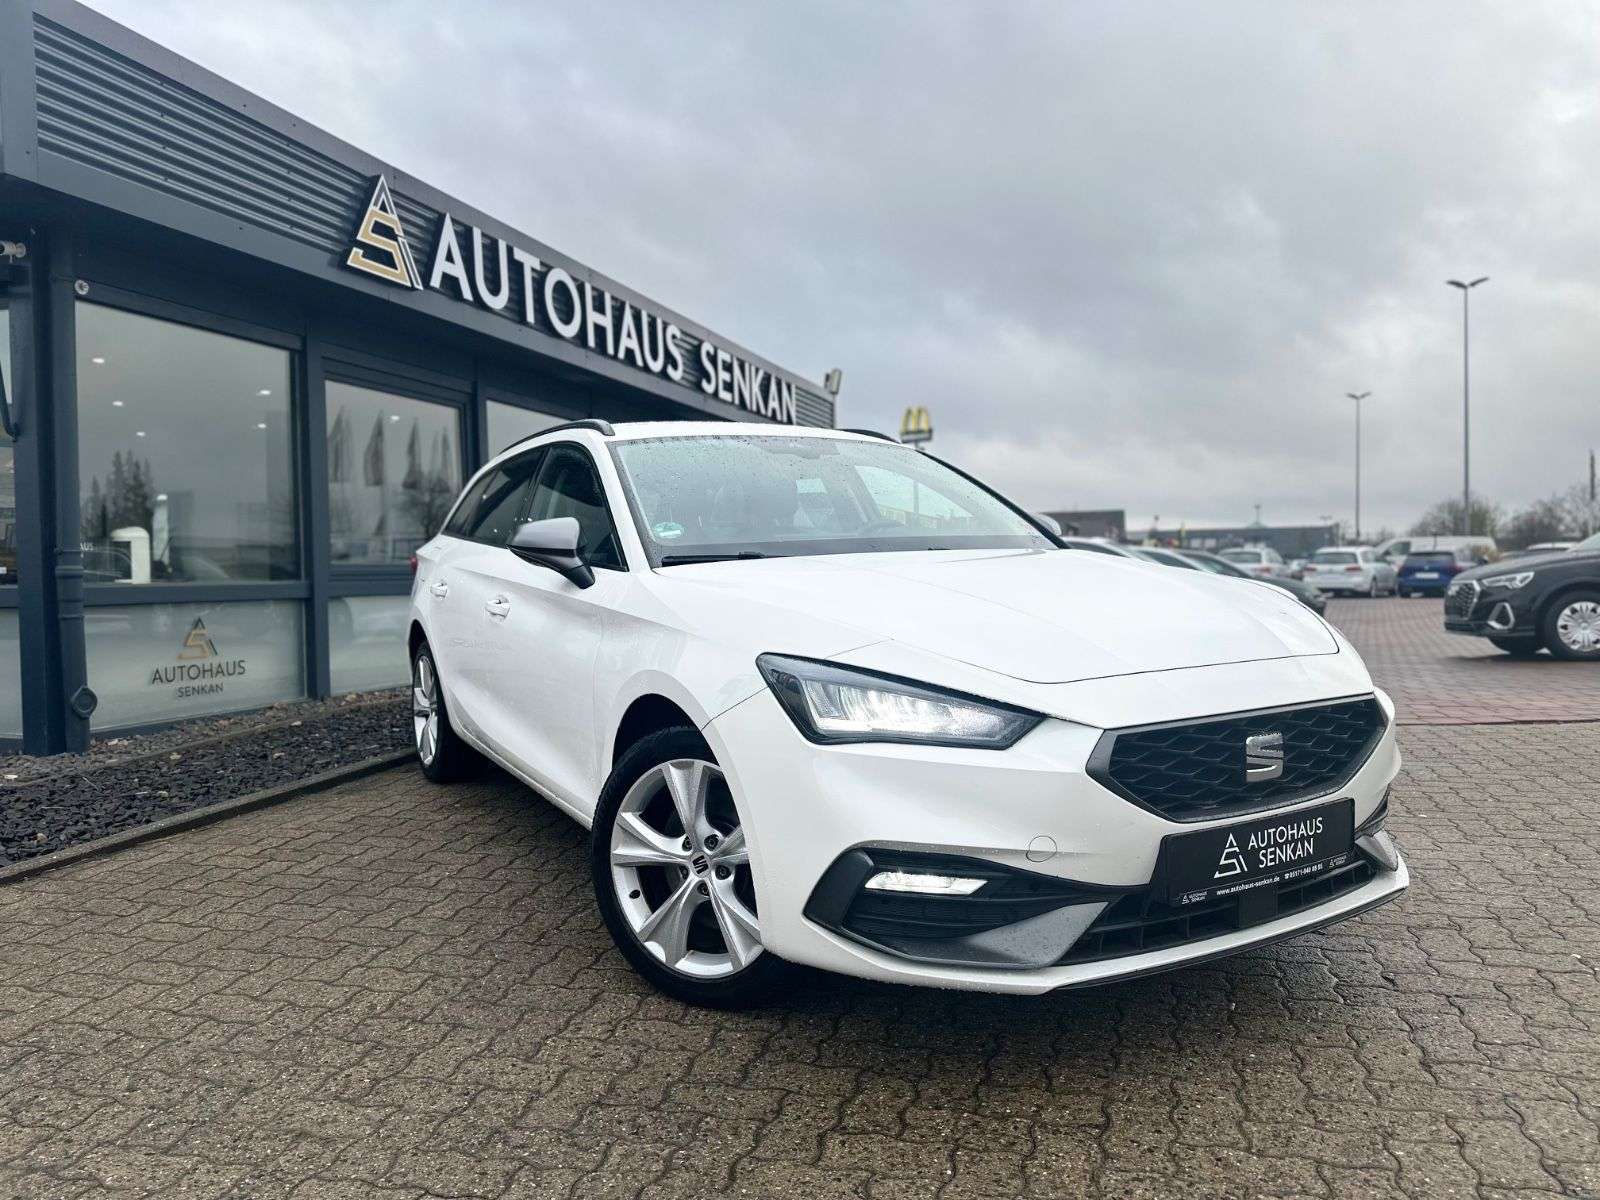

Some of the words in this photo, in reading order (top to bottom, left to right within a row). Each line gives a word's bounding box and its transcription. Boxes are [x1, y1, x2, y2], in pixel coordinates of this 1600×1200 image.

[430, 212, 684, 382] AUTOHAUS
[700, 339, 797, 425] SENKAN
[151, 660, 246, 685] AUTOHAUS
[177, 683, 224, 698] SENKAN
[1247, 816, 1324, 851] AUTOHAUS
[1258, 837, 1315, 868] SENKAN
